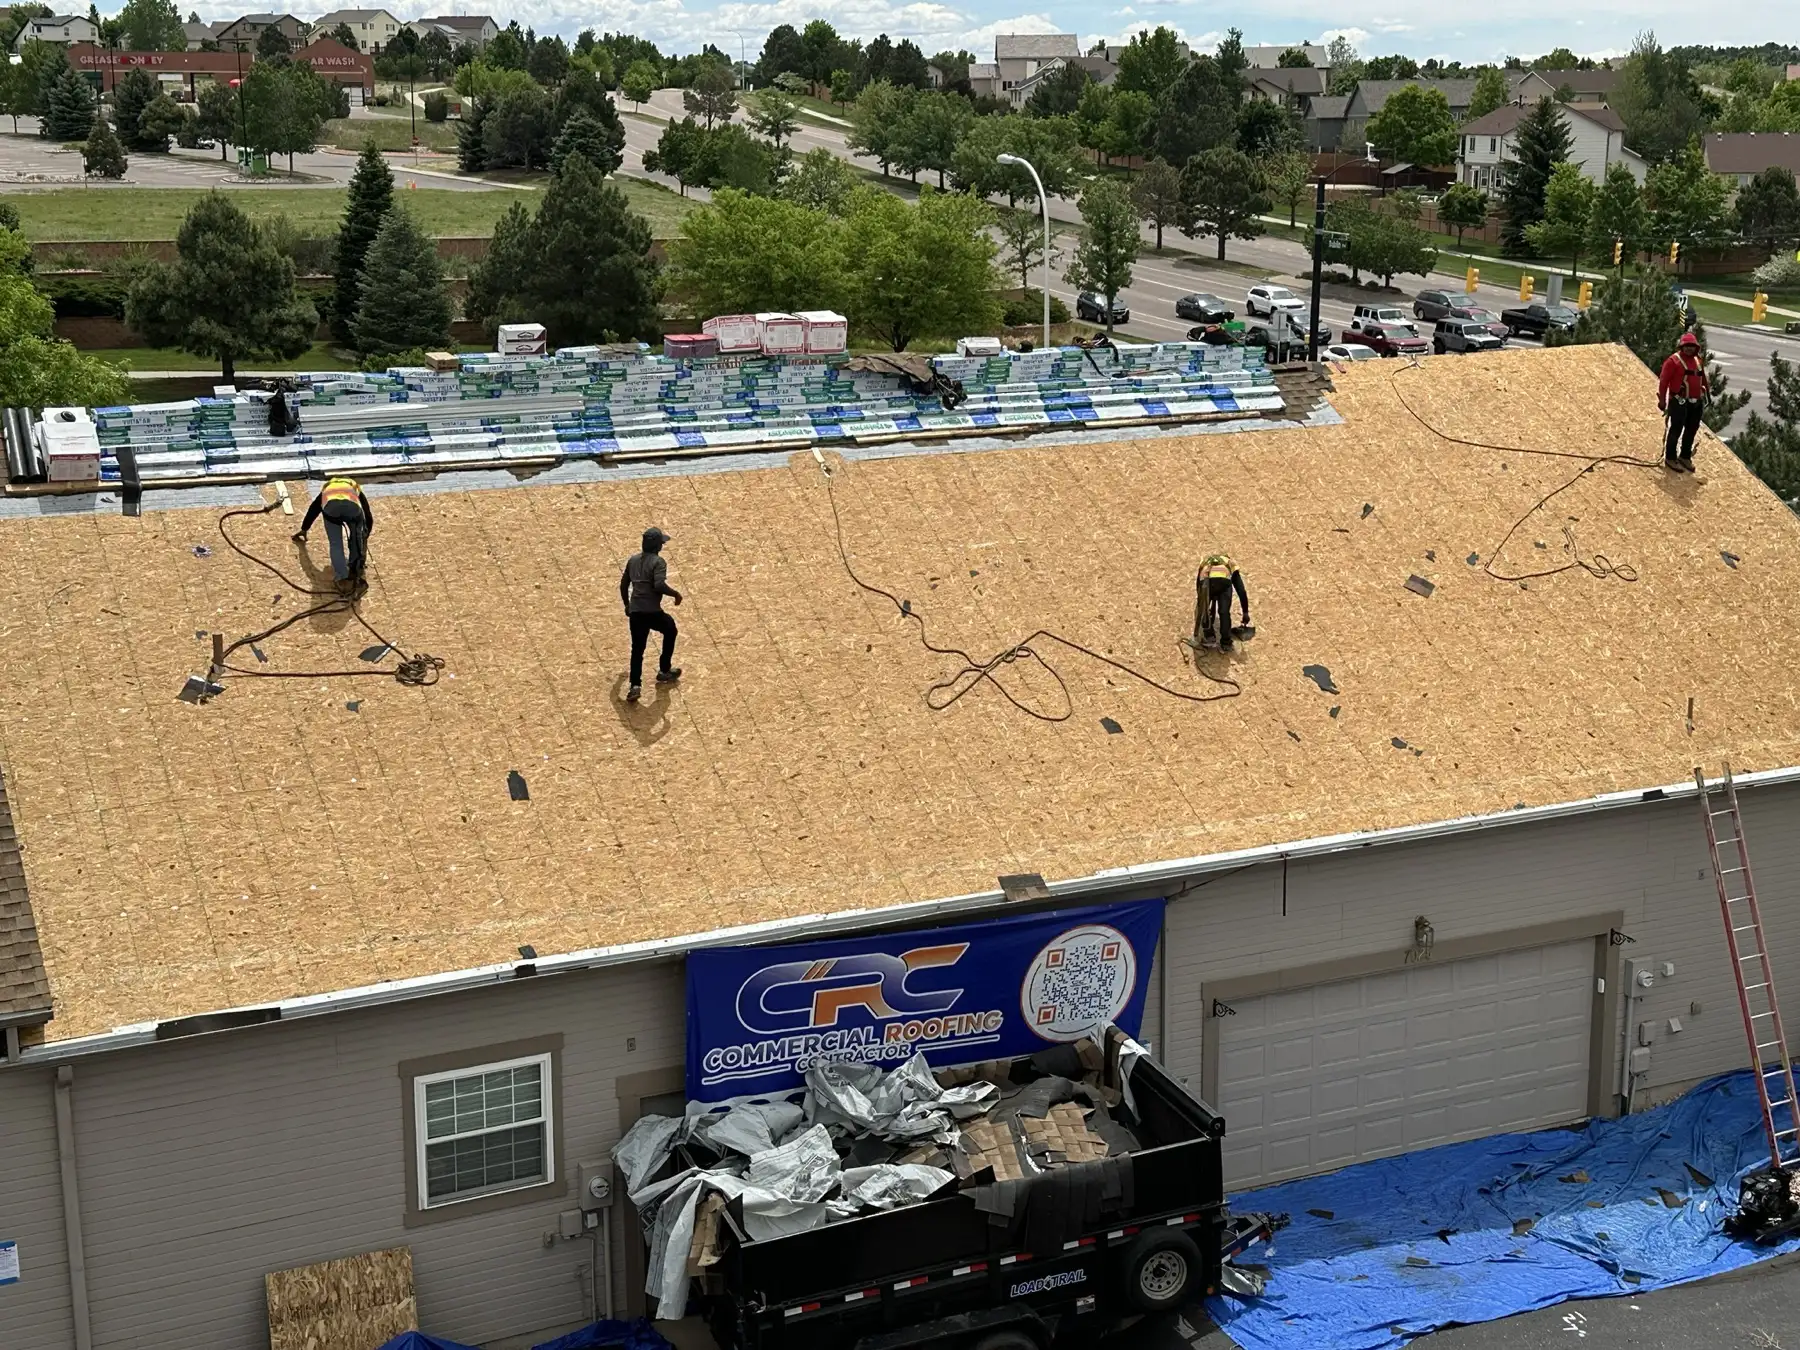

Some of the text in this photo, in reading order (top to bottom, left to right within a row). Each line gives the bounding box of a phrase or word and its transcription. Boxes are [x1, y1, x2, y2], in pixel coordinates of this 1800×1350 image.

[80, 56, 163, 64] GREASE ONEY
[311, 57, 355, 65] AR WASH
[736, 942, 970, 1034] CRC
[702, 1010, 1004, 1073] COMMERCIAL ROOFING
[795, 1042, 911, 1074] CONTRACTOR
[1010, 1268, 1086, 1298] LOAD TRAIL
